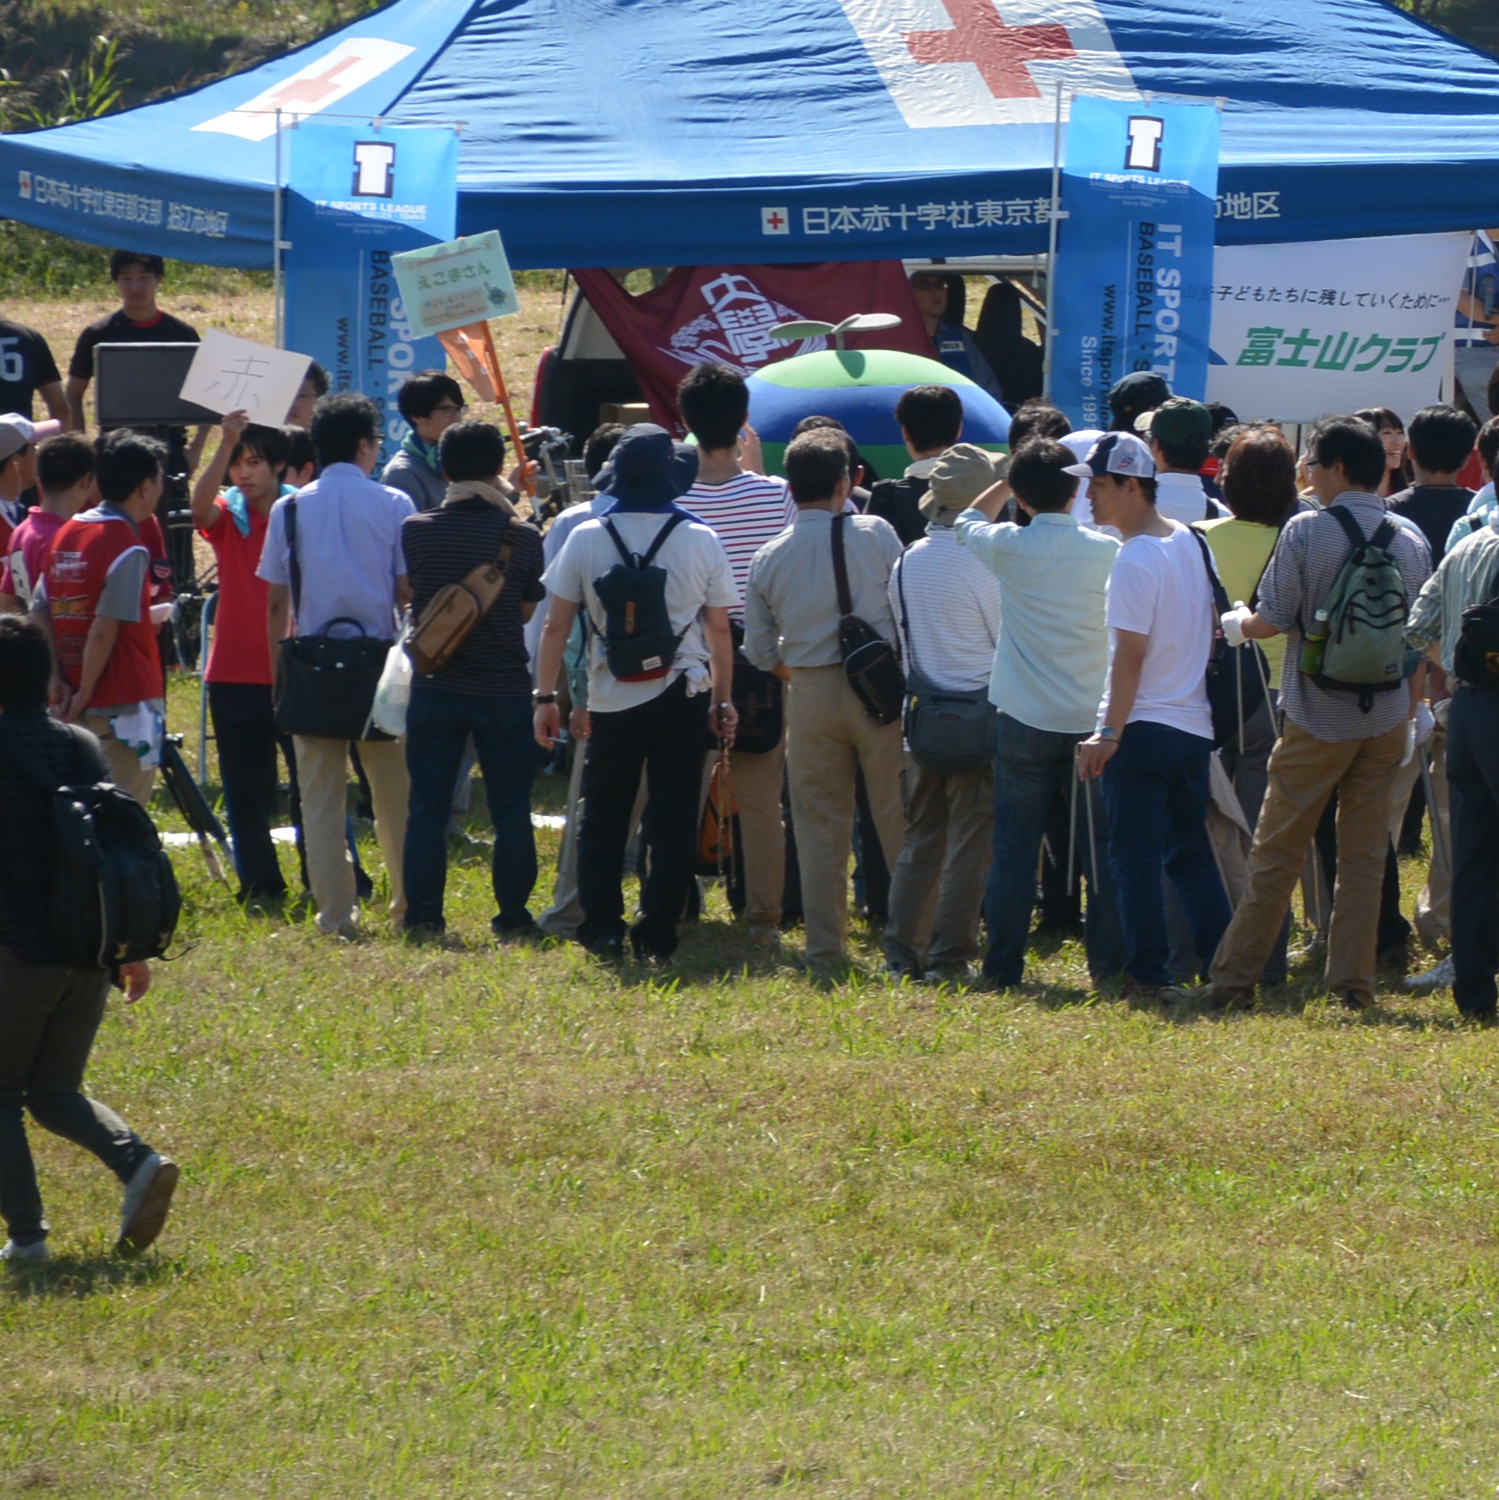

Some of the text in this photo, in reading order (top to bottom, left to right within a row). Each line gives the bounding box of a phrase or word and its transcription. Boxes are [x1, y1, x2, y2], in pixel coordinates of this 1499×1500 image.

[34, 175, 163, 226] 日本赤十字社東京都支部
[1104, 173, 1146, 184] SPORTS
[330, 200, 377, 212] SPORTS
[379, 203, 427, 214] LEAGUE
[416, 260, 492, 291] えこまさん
[1133, 221, 1155, 336] BASEBALL
[368, 250, 390, 370] BASEBALL
[1151, 223, 1182, 396] IT SPORT
[1080, 336, 1098, 387] Since
[1235, 326, 1447, 373] 富士山クラブ
[204, 356, 270, 409] 赤
